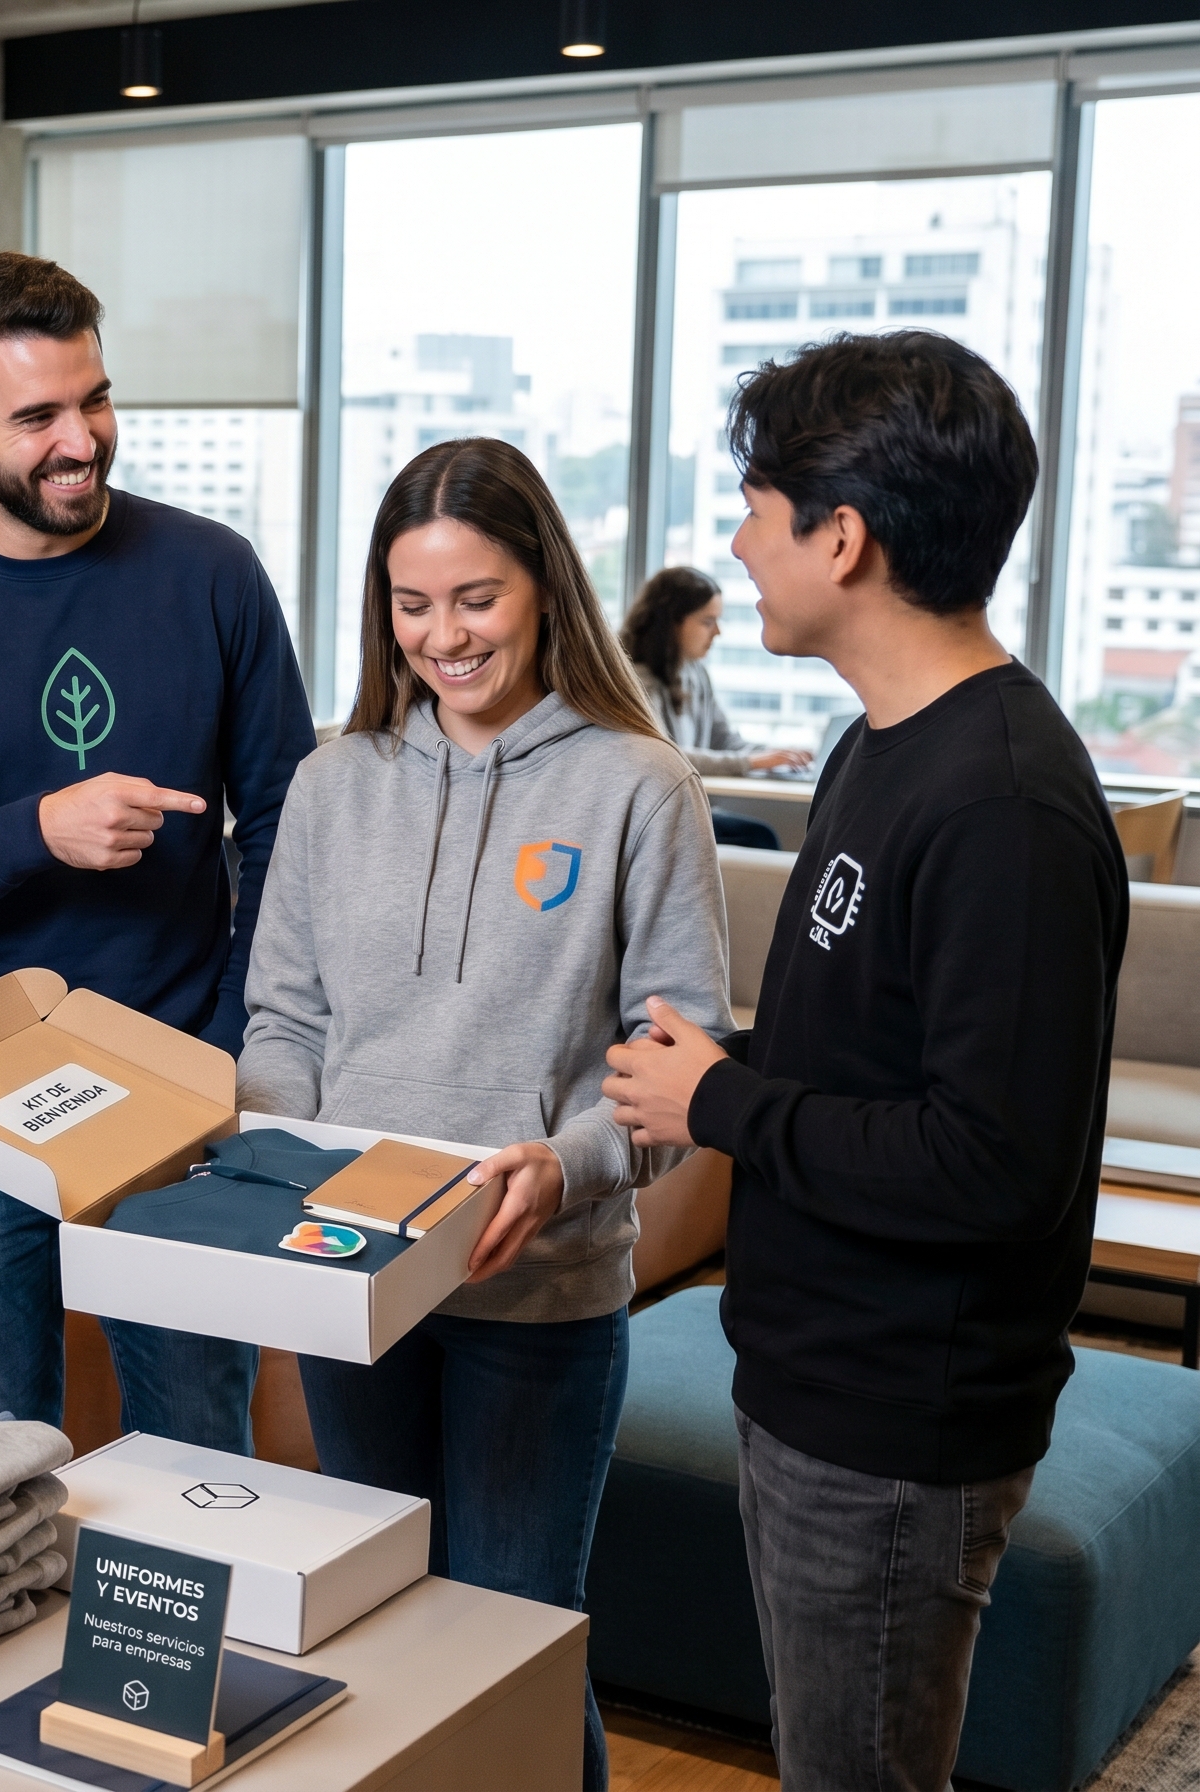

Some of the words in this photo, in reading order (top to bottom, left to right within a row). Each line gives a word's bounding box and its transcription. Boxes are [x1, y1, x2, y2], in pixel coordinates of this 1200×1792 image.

[22, 1093, 49, 1111] KIT
[45, 1082, 71, 1098] DE
[22, 1084, 107, 1132] BIENVENIDA
[96, 1557, 205, 1599] UNIFORMES
[96, 1579, 109, 1598] Y
[113, 1585, 199, 1622] EVENTOS
[84, 1612, 143, 1640] Nuestros
[146, 1631, 205, 1657] servicios
[92, 1635, 122, 1651] para
[125, 1643, 192, 1671] empresas
